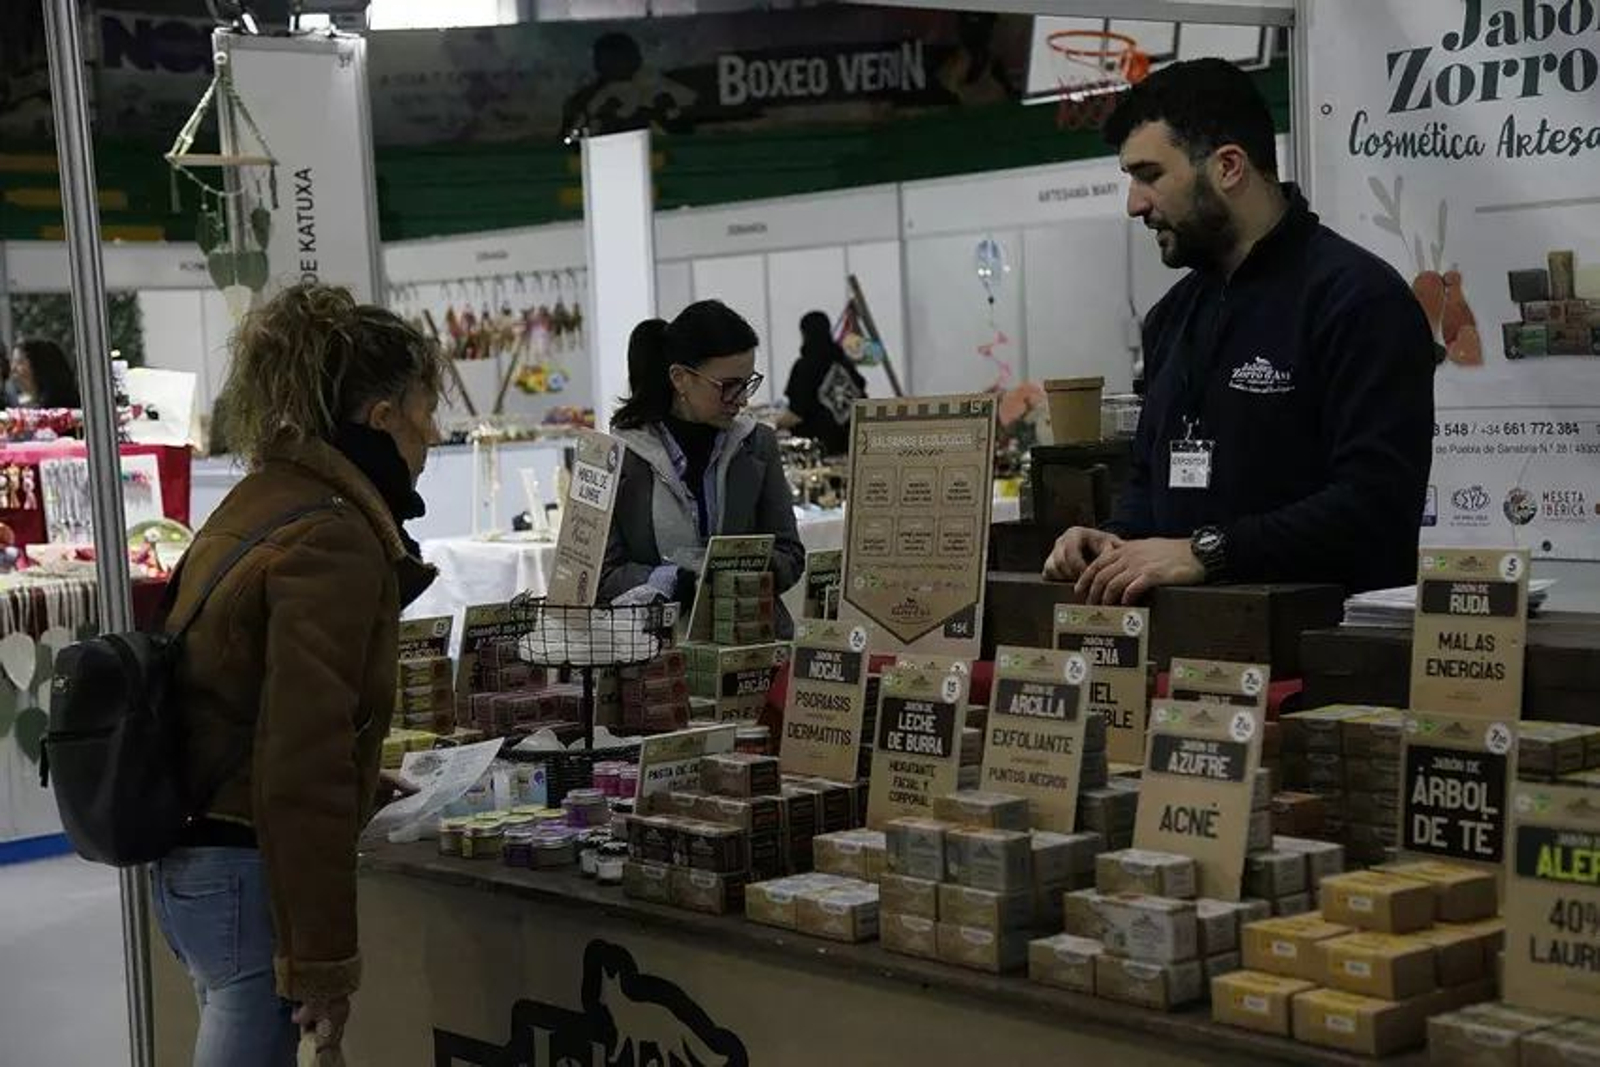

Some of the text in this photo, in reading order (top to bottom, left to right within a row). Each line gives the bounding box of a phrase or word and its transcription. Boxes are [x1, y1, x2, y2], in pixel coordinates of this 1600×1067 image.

[1442, 0, 1600, 51] Jabo
[718, 54, 829, 105] BOXEO
[1386, 47, 1599, 113] Zorro
[1349, 110, 1486, 160] Cosmética
[294, 168, 317, 252] KATUXA
[1445, 423, 1468, 436] 548
[1530, 422, 1553, 435] 772
[1542, 490, 1585, 503] MESETA
[1507, 558, 1517, 572] 5
[1449, 594, 1491, 615] RUDA
[1438, 632, 1495, 652] MALAS
[1082, 646, 1120, 665] ENA
[808, 661, 846, 682] NOGAL
[1426, 656, 1505, 680] ENERGÍAS
[795, 690, 851, 712] PSORIASIS
[1089, 682, 1118, 704] IEL
[1009, 693, 1066, 718] ARCILLA
[788, 722, 851, 746] DERMATITIS
[897, 711, 937, 734] LECHE
[887, 731, 943, 756] DE BURRA
[993, 728, 1073, 754] EXFOLIANTE
[989, 767, 1026, 784] PUNTOS
[1168, 751, 1232, 778] AZUFRE
[1411, 766, 1499, 815] ÁRBOL
[1159, 802, 1221, 839] ACNÉ
[1413, 813, 1494, 855] DE TÉ
